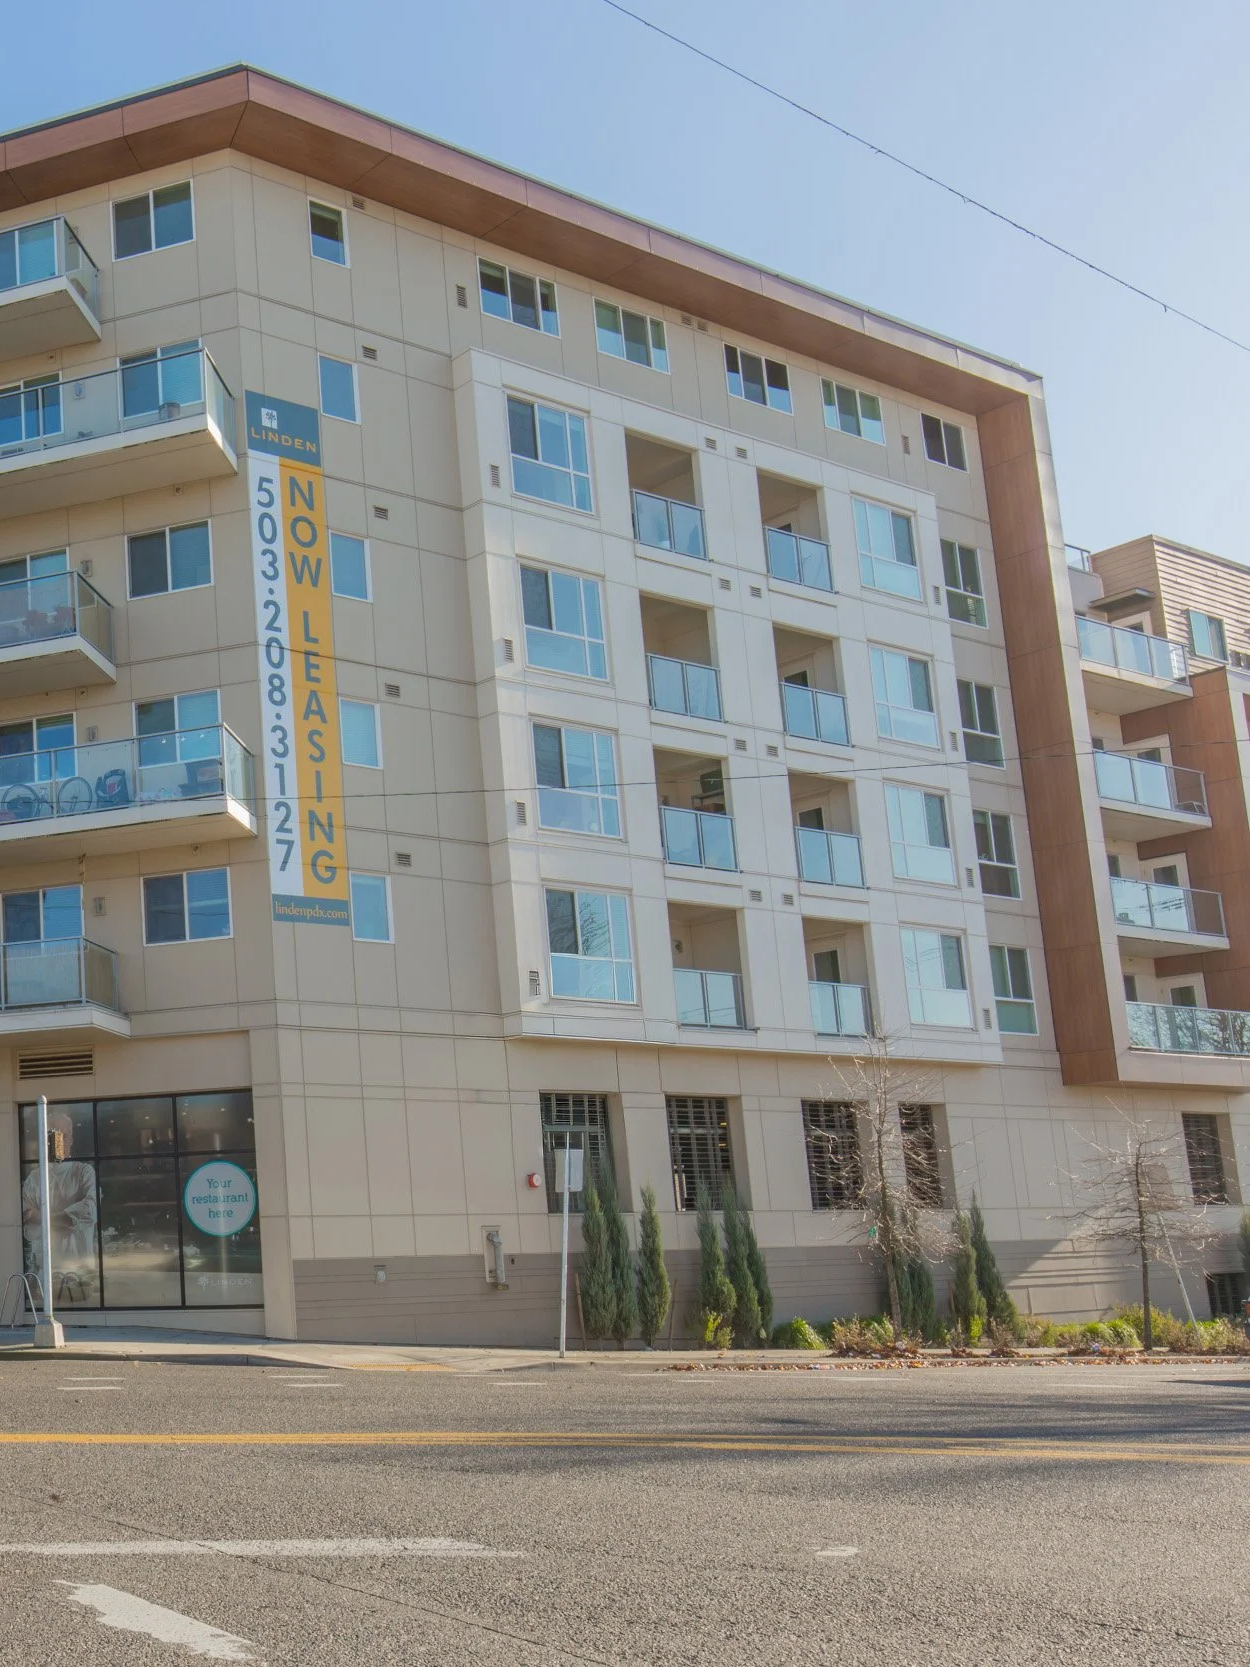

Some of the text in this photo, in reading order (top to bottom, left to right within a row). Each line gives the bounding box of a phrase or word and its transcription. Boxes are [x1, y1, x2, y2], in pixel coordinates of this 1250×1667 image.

[251, 427, 317, 453] LINDEN
[288, 476, 338, 885] NOW LEASING
[275, 901, 348, 920] lindenpdx.com
[206, 1179, 232, 1189] Your
[192, 1193, 249, 1204] restaurant
[209, 1208, 234, 1218] here
[211, 1278, 254, 1286] LINDEN
